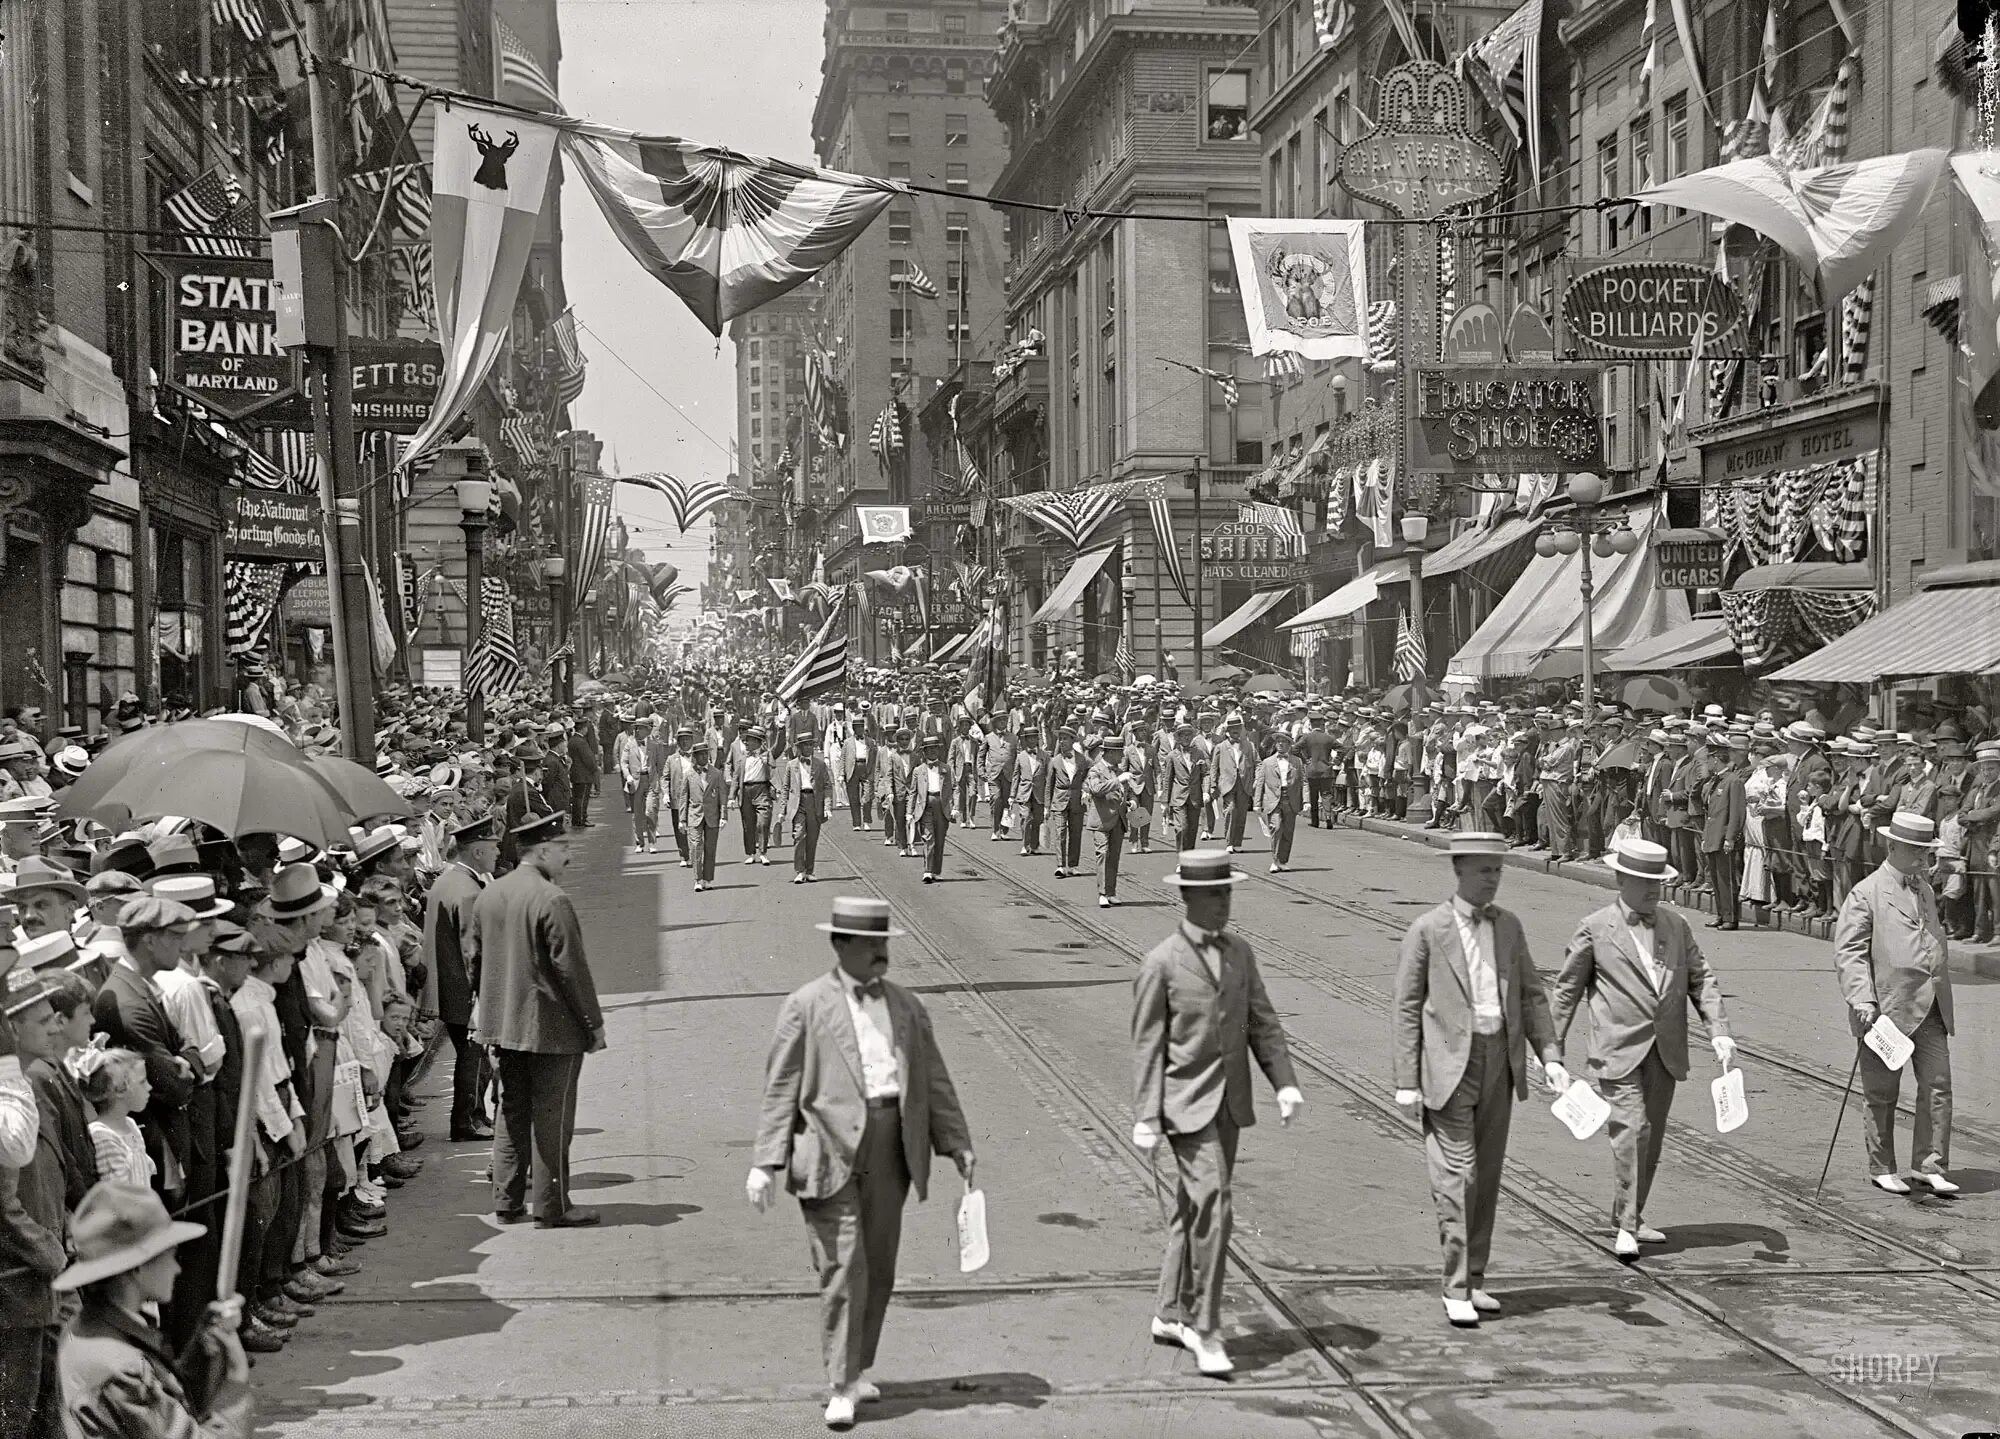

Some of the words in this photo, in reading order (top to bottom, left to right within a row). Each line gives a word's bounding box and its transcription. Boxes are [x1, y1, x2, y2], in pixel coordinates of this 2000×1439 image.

[1350, 142, 1492, 184] OLYMPIA
[1603, 279, 1705, 303] POCKET
[1591, 311, 1718, 336] BILLIARDS
[180, 319, 287, 356] BANK
[221, 357, 244, 372] OF
[186, 373, 279, 391] MARYLAND
[1418, 370, 1597, 419] EDUCATOR
[1801, 428, 1853, 457] HOTEL
[236, 496, 260, 519] The
[261, 499, 309, 521] National
[225, 520, 273, 548] Sporting
[273, 525, 307, 548] Goods
[1223, 524, 1265, 535] SHOE
[1660, 546, 1719, 562] UNITED
[1204, 566, 1234, 578] HATS
[1240, 566, 1288, 578] CLEANED
[1661, 568, 1720, 586] CIGARS
[298, 579, 328, 588] UBLIC
[402, 568, 415, 623] SODA
[936, 614, 965, 624] SHINES
[944, 604, 966, 613] SHOP
